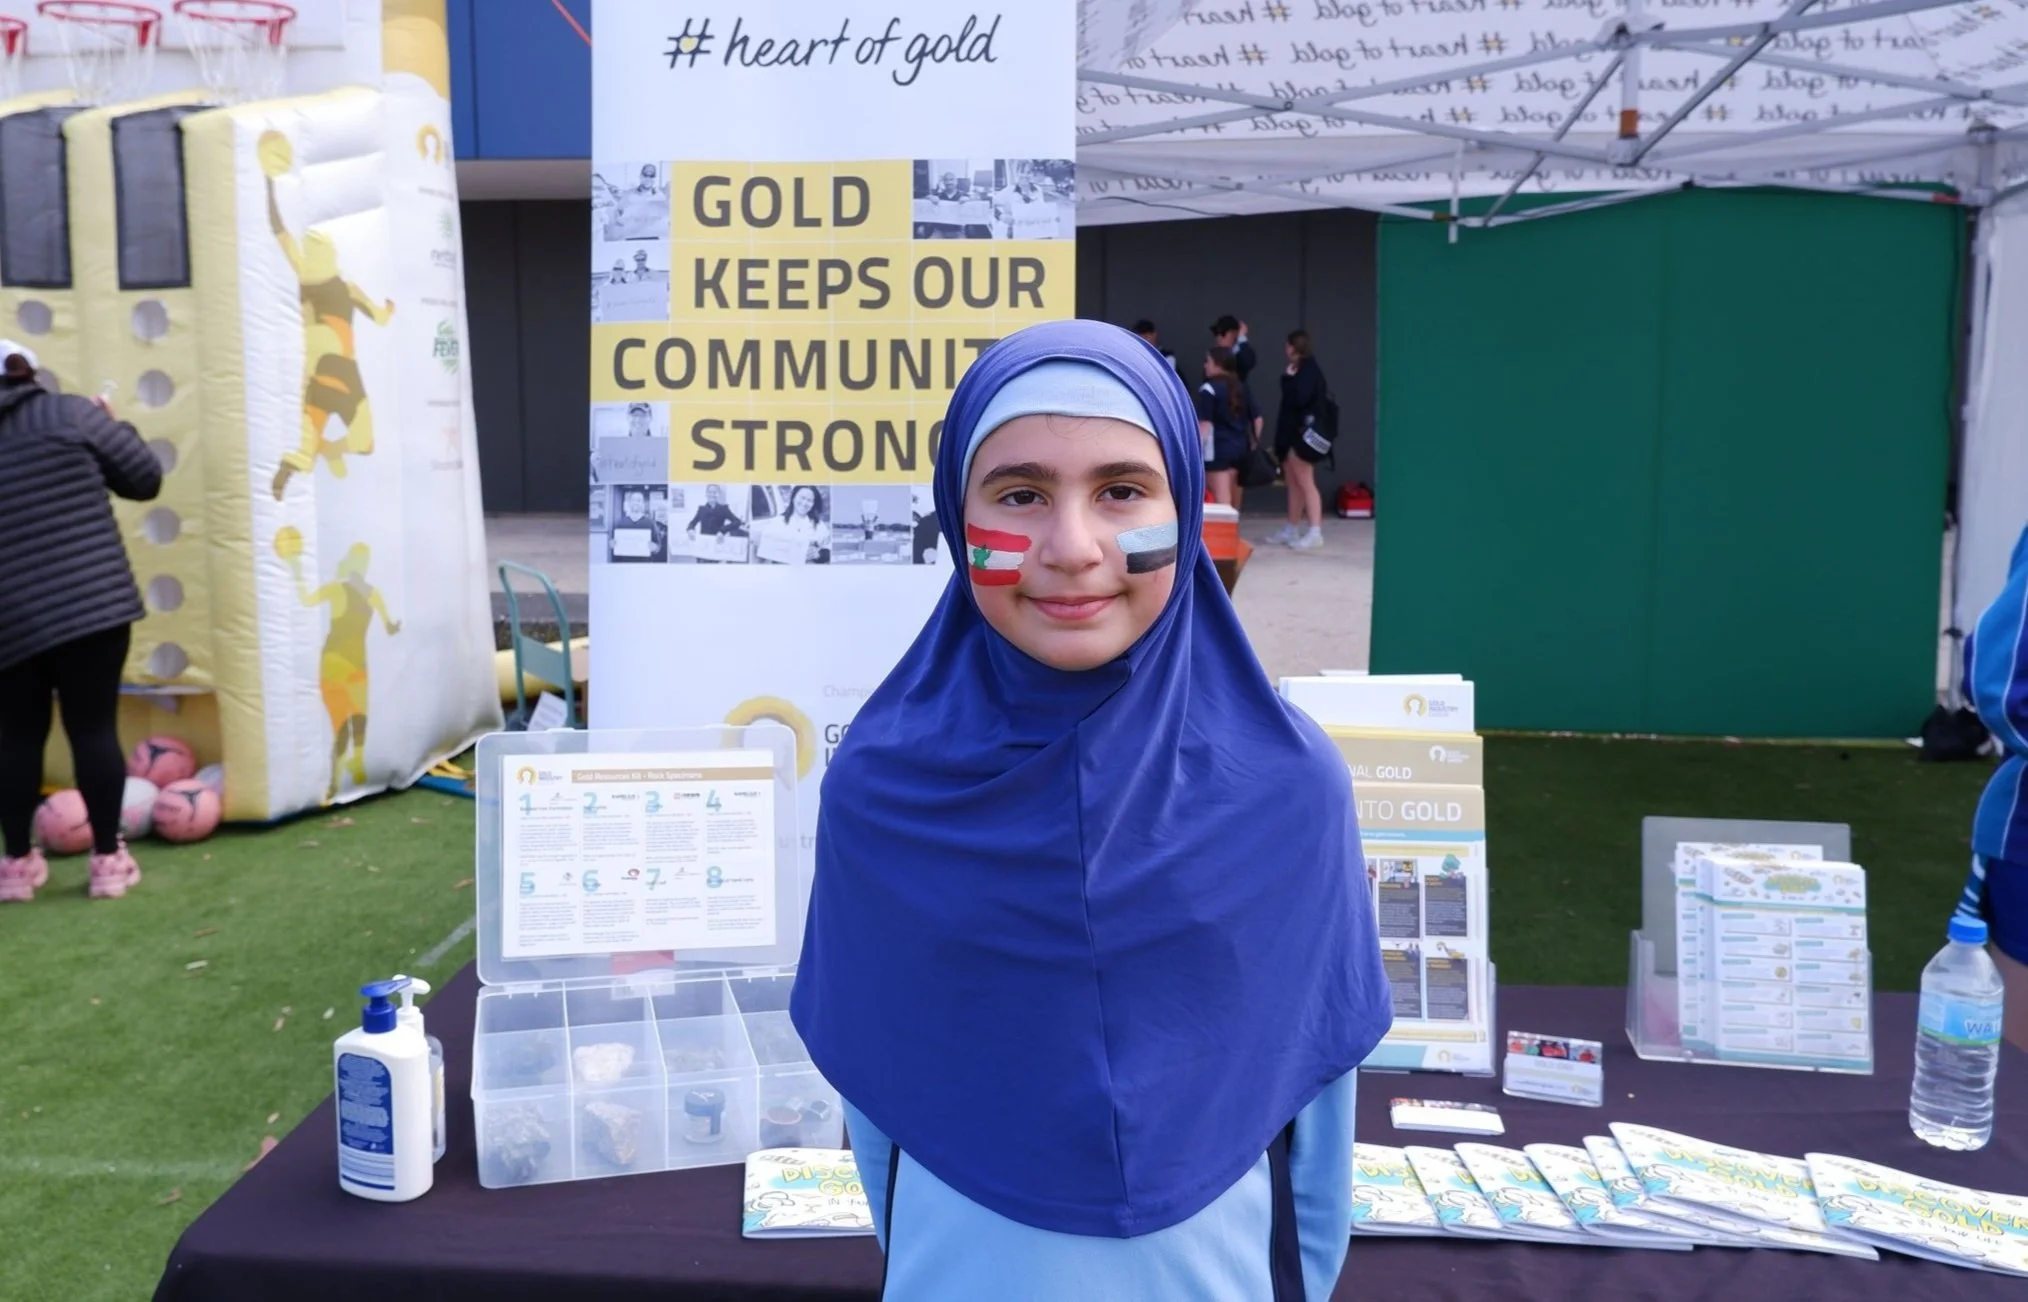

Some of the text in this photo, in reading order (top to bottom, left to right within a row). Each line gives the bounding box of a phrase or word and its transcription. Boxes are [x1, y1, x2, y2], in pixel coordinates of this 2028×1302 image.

[854, 17, 902, 65] of
[893, 14, 1002, 86] gold
[693, 176, 871, 229] GOLD
[694, 257, 1046, 310] KEEPS OUR
[614, 338, 999, 391] COMMUNIT
[691, 419, 938, 471] STRON
[1376, 766, 1412, 780] GOLD
[518, 792, 533, 816] 1
[583, 792, 598, 815] 2
[645, 790, 660, 813] 3
[706, 790, 722, 812] 4
[1401, 801, 1462, 821] GOLD
[520, 872, 535, 895] 5
[582, 869, 599, 892] 6
[646, 868, 660, 890] 7
[706, 866, 722, 888] 8
[781, 1165, 861, 1184] DISC
[818, 1179, 865, 1197] GO
[1902, 1197, 2005, 1237] GOLD
